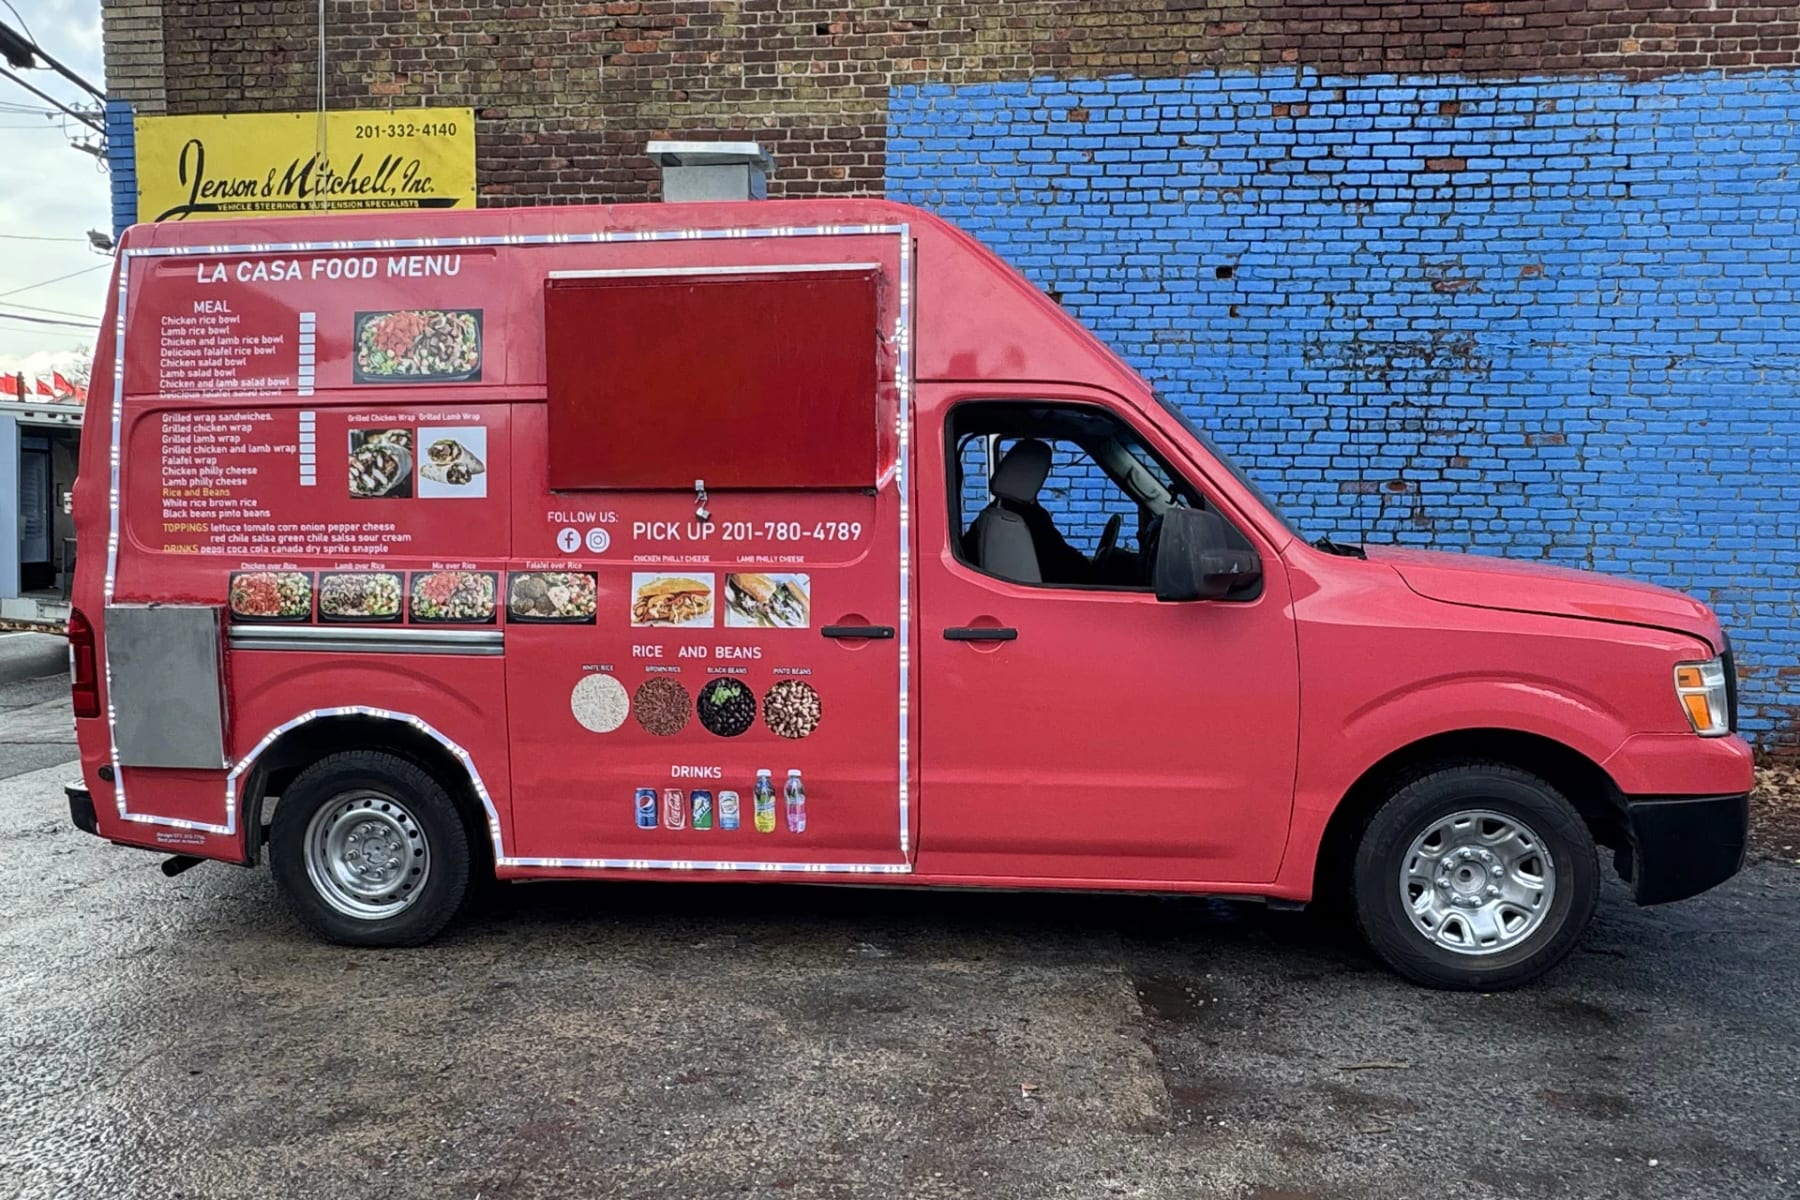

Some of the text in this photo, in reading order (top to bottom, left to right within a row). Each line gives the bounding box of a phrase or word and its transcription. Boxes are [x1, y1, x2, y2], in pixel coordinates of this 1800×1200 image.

[355, 123, 457, 139] 201-332-4140
[176, 139, 435, 219] Jenson & Mitchell, Inc.
[217, 199, 419, 211] VEHICLE STEERING & SUSPENSION SPECIALISTS
[196, 254, 461, 284] LA CASA FOOD MENU
[194, 301, 231, 313] MEAL
[161, 316, 196, 325] Chicken
[218, 315, 240, 323] bowl
[161, 328, 186, 336] Lamb
[208, 326, 230, 335] bowl
[161, 338, 196, 346] Chicken
[199, 337, 215, 345] and
[218, 337, 240, 345] lamb
[262, 335, 284, 344] bowl
[161, 346, 276, 356] Delicious falafel rice bowl
[160, 358, 246, 367] Chicken salad bowl
[160, 368, 236, 378] Lamb salad bowl
[160, 377, 290, 388] Chicken and lamb salad bowl
[162, 412, 273, 423] Grilled wrap sandwiches.
[348, 414, 369, 422] Grilled
[398, 414, 415, 422] Wrap
[463, 413, 480, 421] Wrap
[162, 424, 252, 433] Grilled chicken wrap
[162, 435, 240, 444] Grilled lamb wrap
[162, 444, 296, 454] Grilled chicken and lamb wrap
[162, 456, 217, 466] Falafel wrap
[162, 466, 258, 476] Chicken philly cheese
[162, 477, 247, 488] Lamb philly cheese
[162, 488, 230, 496] Rice and Beans
[162, 499, 188, 507] White
[190, 499, 206, 507] rice
[240, 498, 257, 506] rice
[163, 509, 270, 519] Black beans pinto beans
[548, 512, 619, 523] FOLLOW US:
[163, 523, 208, 532] TOPPINGS
[211, 523, 241, 532] lettuce
[244, 523, 275, 532] tomato
[301, 523, 325, 531] onion
[328, 523, 360, 533] pepper
[362, 522, 395, 531] cheese
[633, 522, 862, 541] PICK UP 201-780-4789
[211, 534, 412, 544] red chile salsa green chile salsa sour cream
[163, 545, 199, 553] DRINKS
[272, 545, 303, 553] canada
[306, 545, 320, 554] dry
[323, 544, 350, 554] sprite
[352, 544, 388, 554] snapple
[632, 646, 762, 659] RICE AND BEANS
[672, 766, 721, 778] DRINKS
